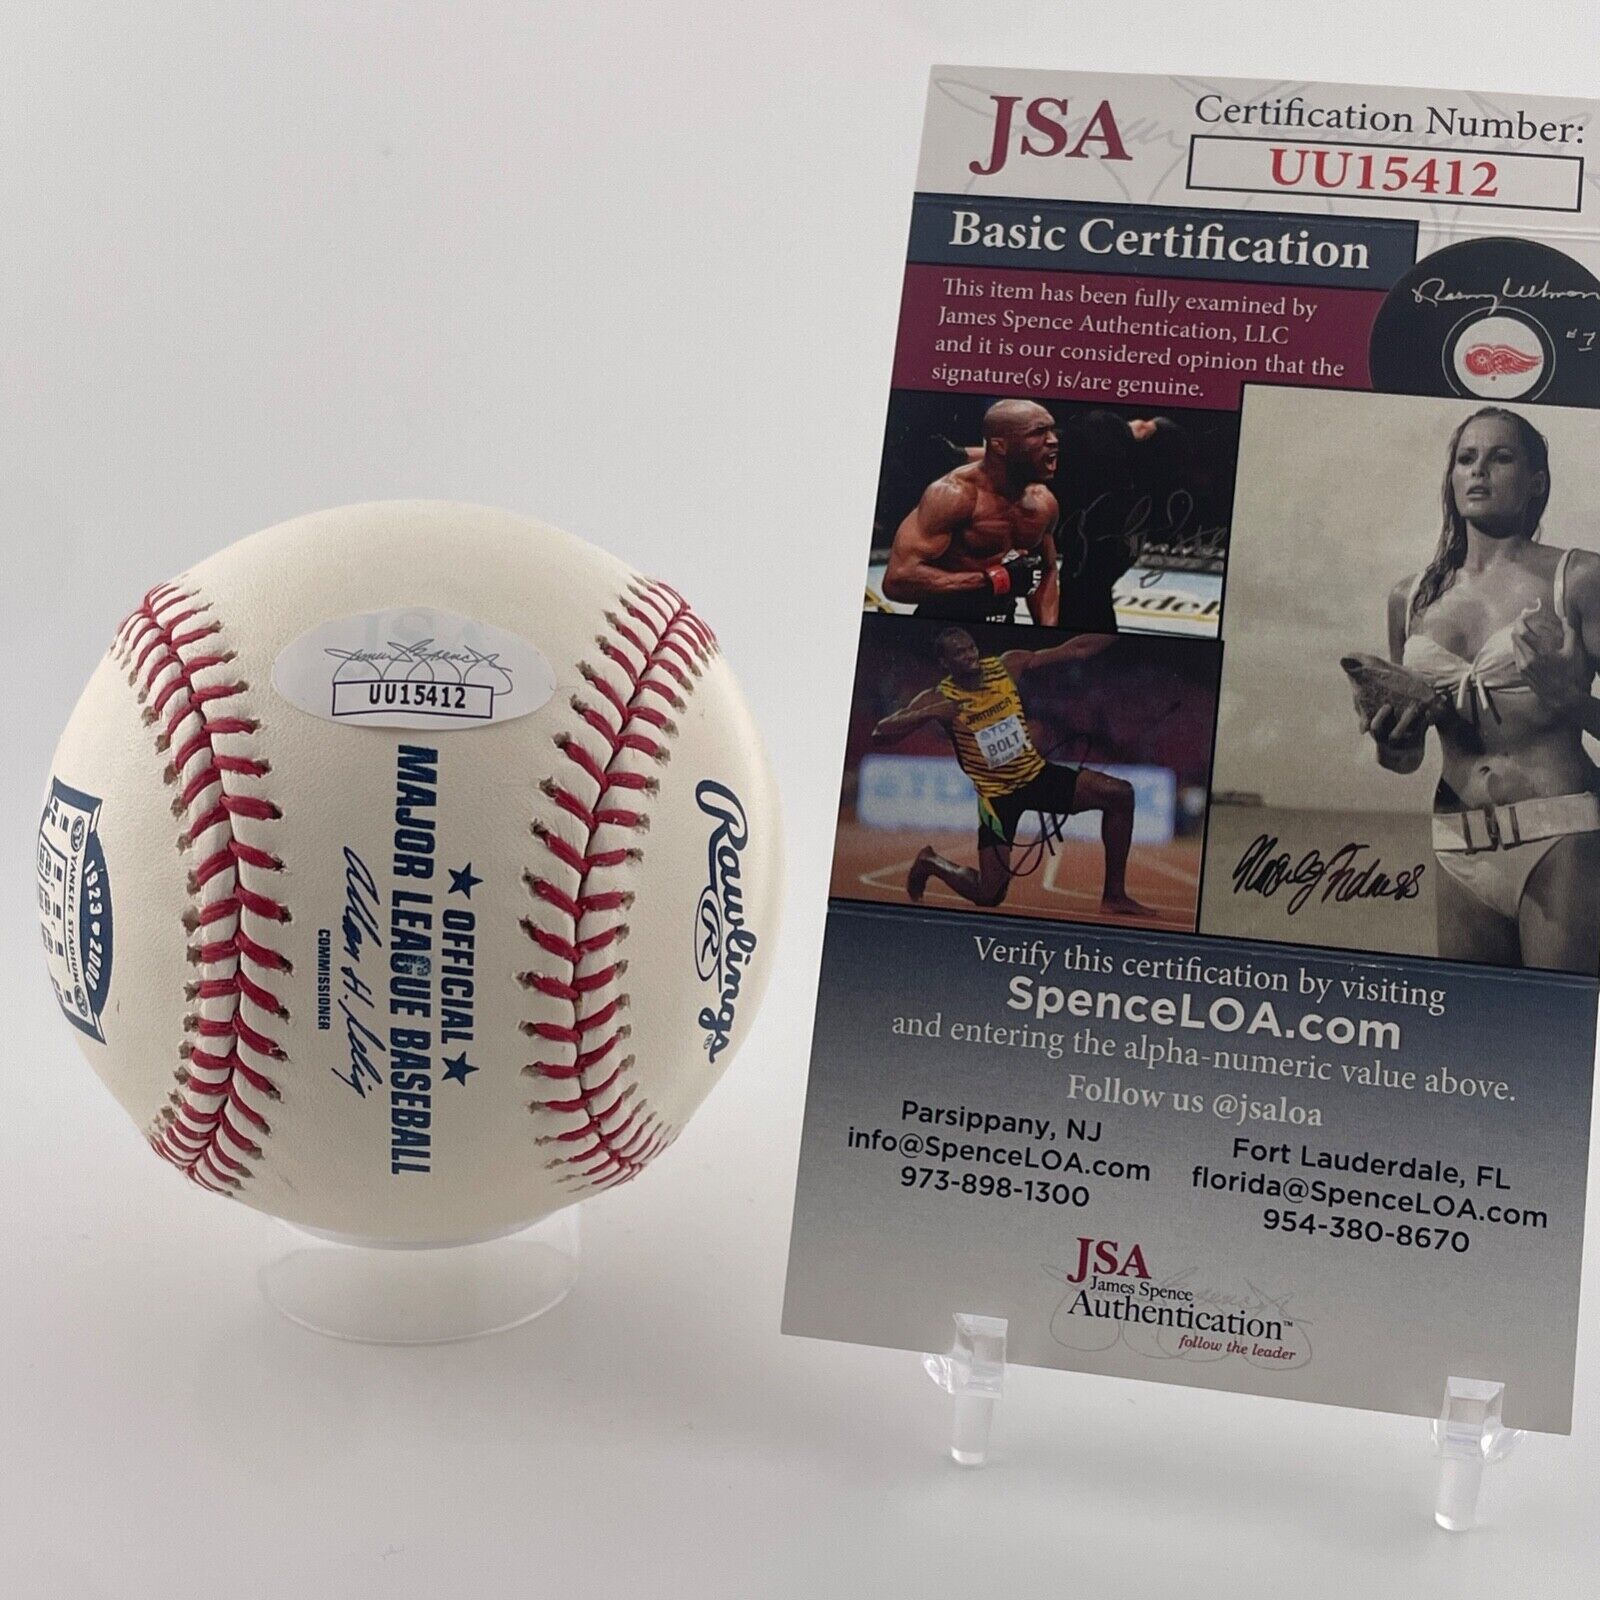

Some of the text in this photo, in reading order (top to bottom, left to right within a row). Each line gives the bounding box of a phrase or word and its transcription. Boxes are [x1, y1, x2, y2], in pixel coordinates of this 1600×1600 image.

[969, 95, 1133, 175] JSA
[1194, 94, 1584, 144] Certification Number:
[1270, 148, 1499, 197] UU15412
[949, 211, 1370, 270] Basic Certification
[938, 306, 1289, 344] James Spence Authentication, LLC
[943, 278, 1317, 322] This item has been fully examined by
[932, 364, 1204, 398] signature(s) is/are genuine.
[935, 335, 1345, 377] and it is our considered opinion that the
[369, 683, 466, 709] UU15412
[987, 730, 1020, 757] BOLT
[84, 860, 103, 915] 1923
[318, 929, 330, 1030] COMMISSIONER
[390, 744, 438, 1175] MAJOR LEAGUE BASEBALL
[441, 909, 475, 1044] OFFICIAL
[974, 936, 1447, 1016] Verify this certification by visiting
[1006, 975, 1400, 1050] SpenceLOA.com
[892, 1012, 1516, 1102] and entering the alpha-numeric value above.
[901, 1100, 1102, 1142] Parsippany, NJ
[1067, 1073, 1323, 1127] Follow us @jsaloa
[848, 1126, 1151, 1182] info@SpenceLOA.com
[1233, 1137, 1511, 1190] Fort Lauderdale, FL
[901, 1166, 1090, 1207] 973-898-1300
[1192, 1166, 1548, 1229] florida@SpenceLOA.com
[1264, 1209, 1470, 1253] 954-380-8670
[1066, 1237, 1152, 1283] JSA
[1090, 1275, 1194, 1302] James Spence
[1178, 1335, 1297, 1361] follow the leader
